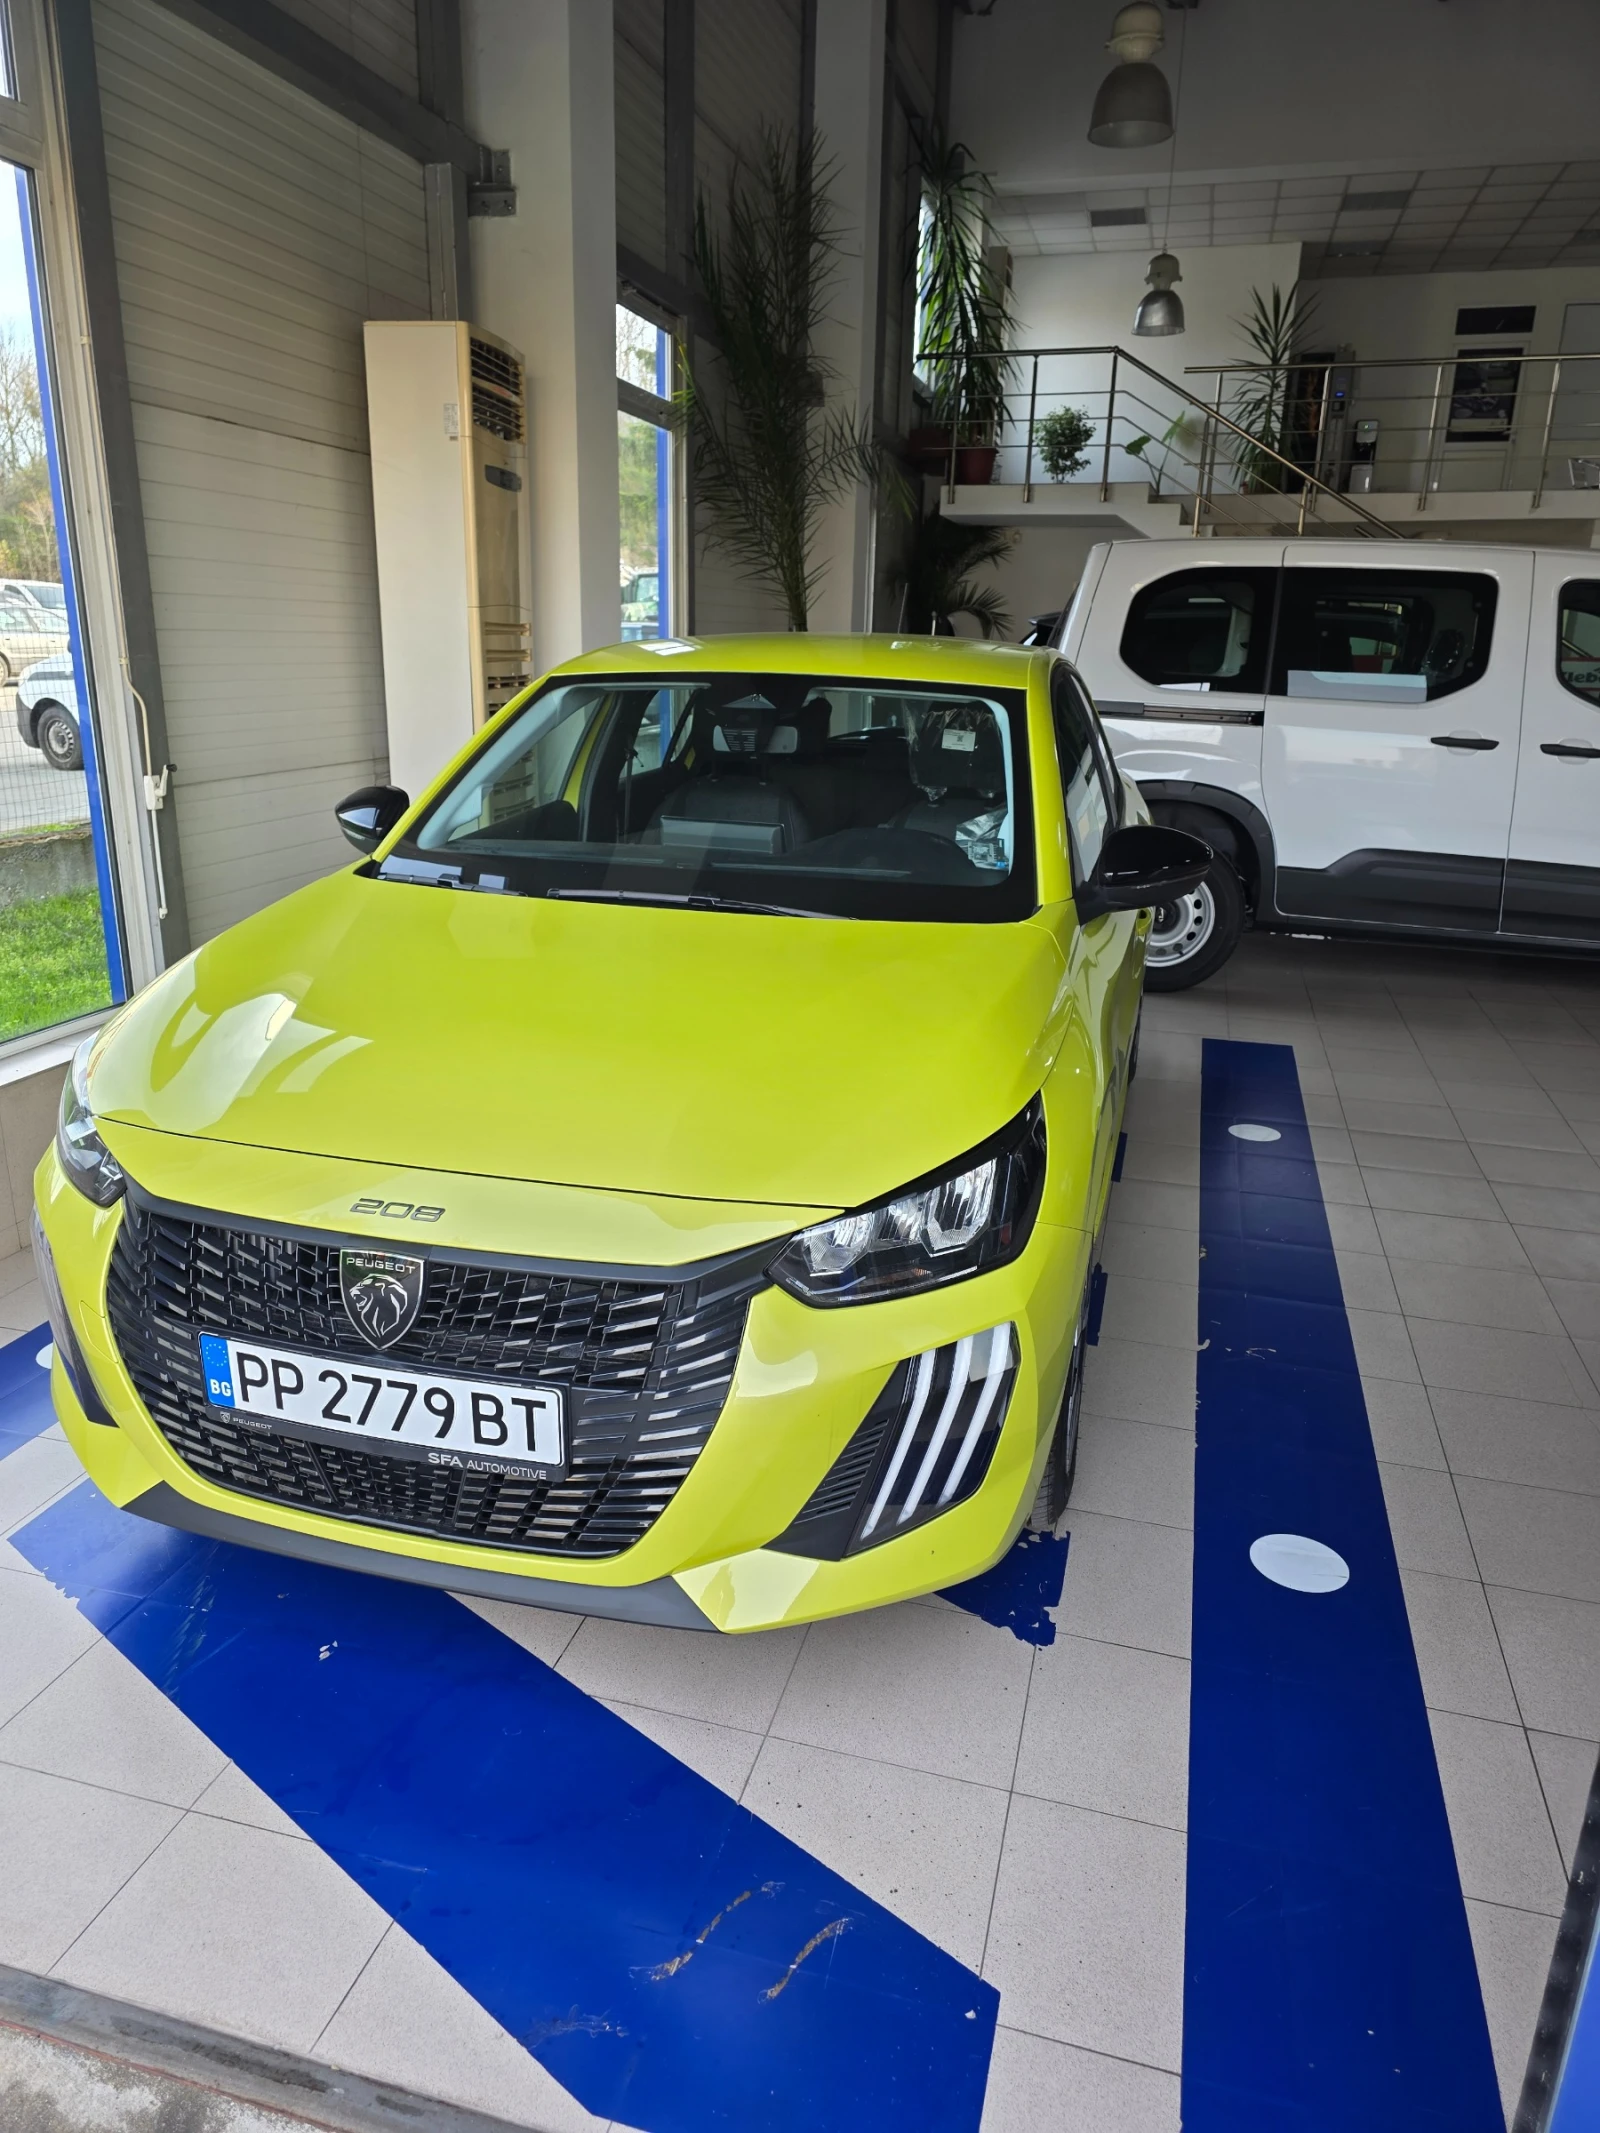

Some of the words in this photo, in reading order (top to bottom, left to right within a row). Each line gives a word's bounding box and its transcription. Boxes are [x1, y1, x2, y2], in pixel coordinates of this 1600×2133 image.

[350, 1198, 446, 1222] 208
[346, 1257, 416, 1274] PEUGEOT
[210, 1378, 232, 1397] BG
[236, 1351, 304, 1410] PP
[318, 1369, 455, 1439] 2779
[471, 1392, 546, 1452] BT
[232, 1417, 273, 1430] PEUGEOT
[427, 1452, 464, 1468] SFA
[466, 1459, 547, 1480] AUTOMOTIVE
